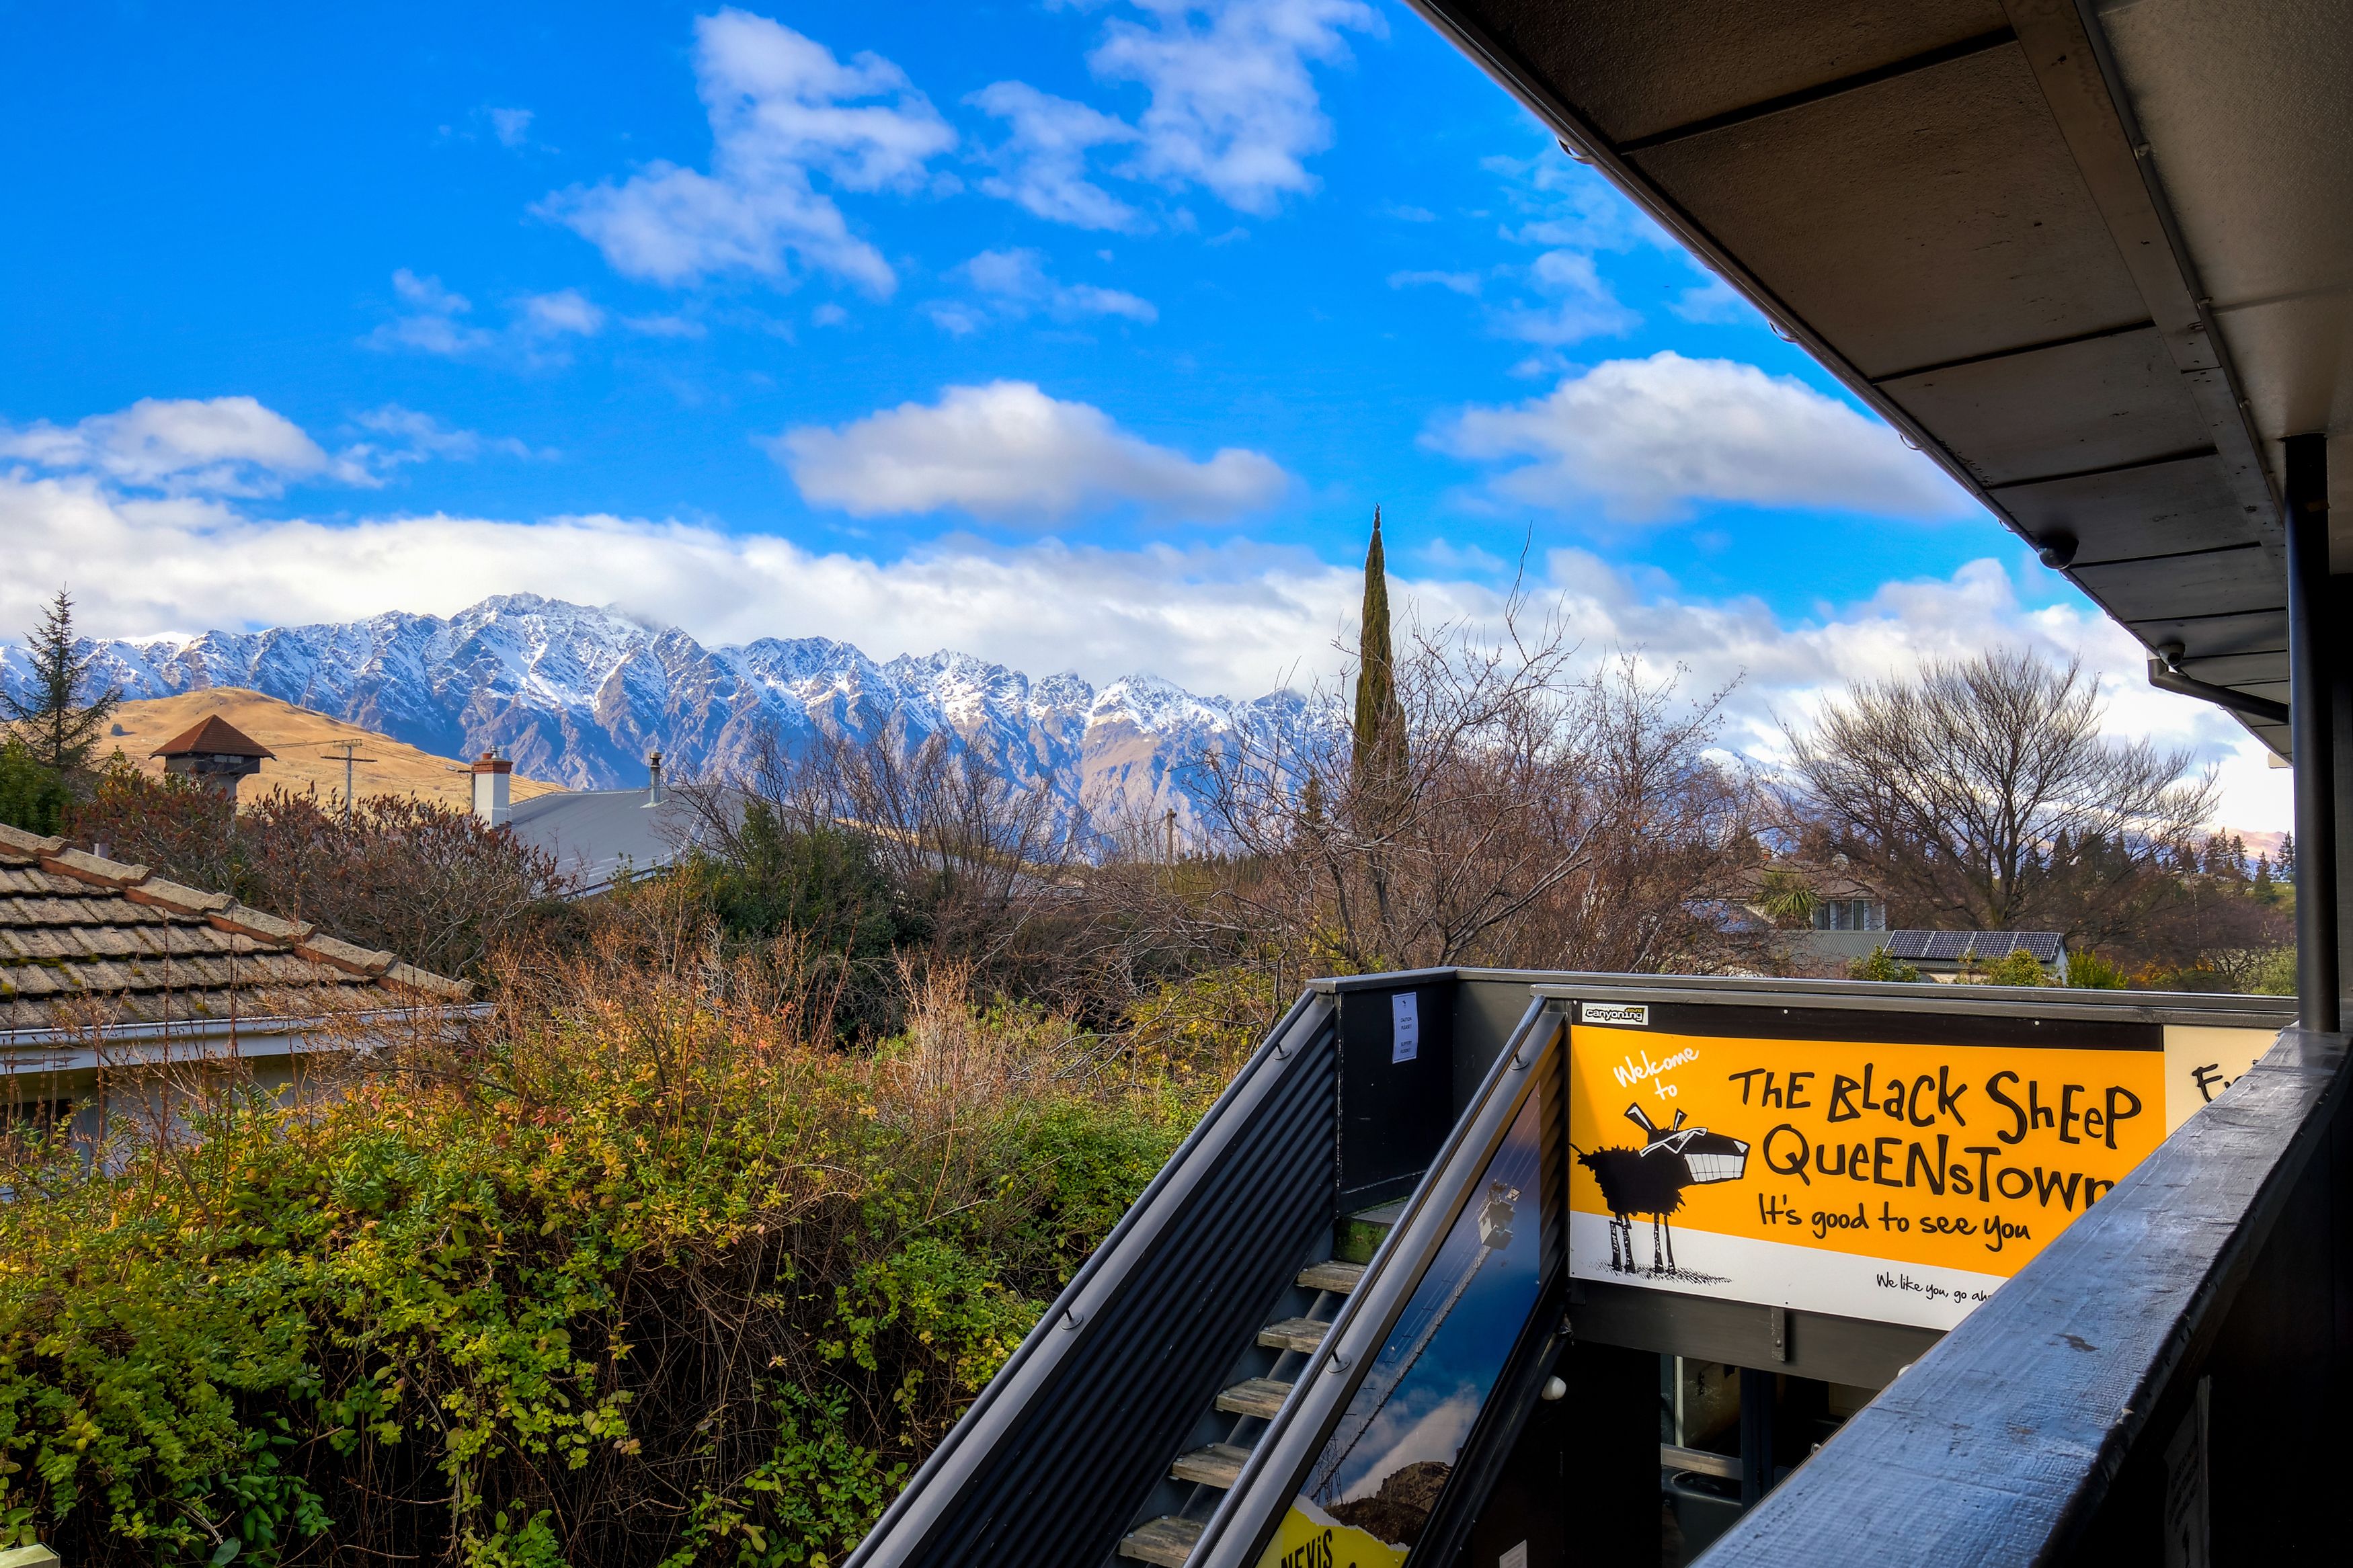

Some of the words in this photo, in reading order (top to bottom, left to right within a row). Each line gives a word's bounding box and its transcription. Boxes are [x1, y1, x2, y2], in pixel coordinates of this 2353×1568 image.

[1613, 1047, 1700, 1087] Welcome
[1654, 1077, 1677, 1100] to
[1759, 1193, 1802, 1225] It's
[1812, 1202, 1870, 1239] good
[1878, 1201, 1910, 1233] to
[1920, 1216, 1978, 1235] see
[1984, 1215, 2031, 1252] you
[1876, 1272, 1898, 1288] We
[1900, 1274, 1923, 1292] like
[1925, 1284, 1949, 1301] you,
[1954, 1291, 1967, 1304] go
[1281, 1528, 1332, 1568] ViS
